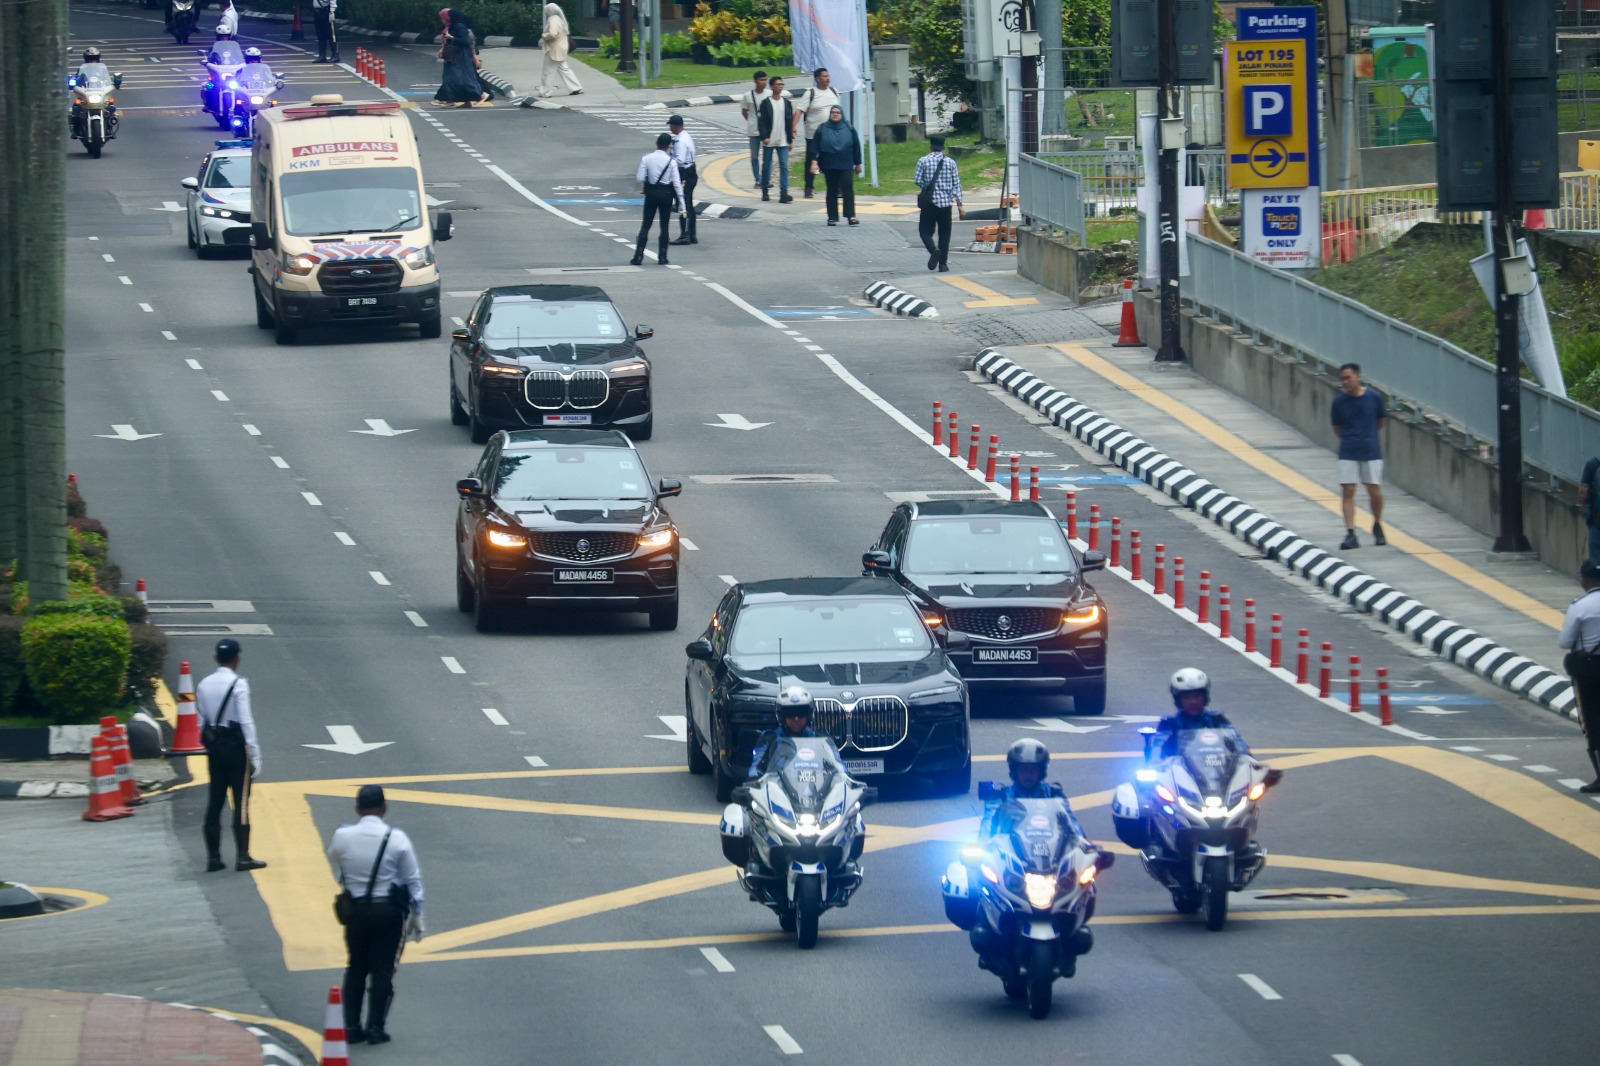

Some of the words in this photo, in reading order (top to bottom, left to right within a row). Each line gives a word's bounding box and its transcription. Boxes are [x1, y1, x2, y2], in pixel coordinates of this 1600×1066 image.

[1248, 14, 1307, 28] Parking
[1237, 50, 1264, 61] LOT
[1269, 49, 1295, 60] 195
[1252, 91, 1285, 130] P
[300, 142, 394, 156] AMBULANS
[289, 159, 320, 170] KKM
[1262, 195, 1283, 203] PAY
[1286, 195, 1301, 203] BY
[1265, 213, 1298, 221] Touch
[1267, 239, 1297, 247] ONLY
